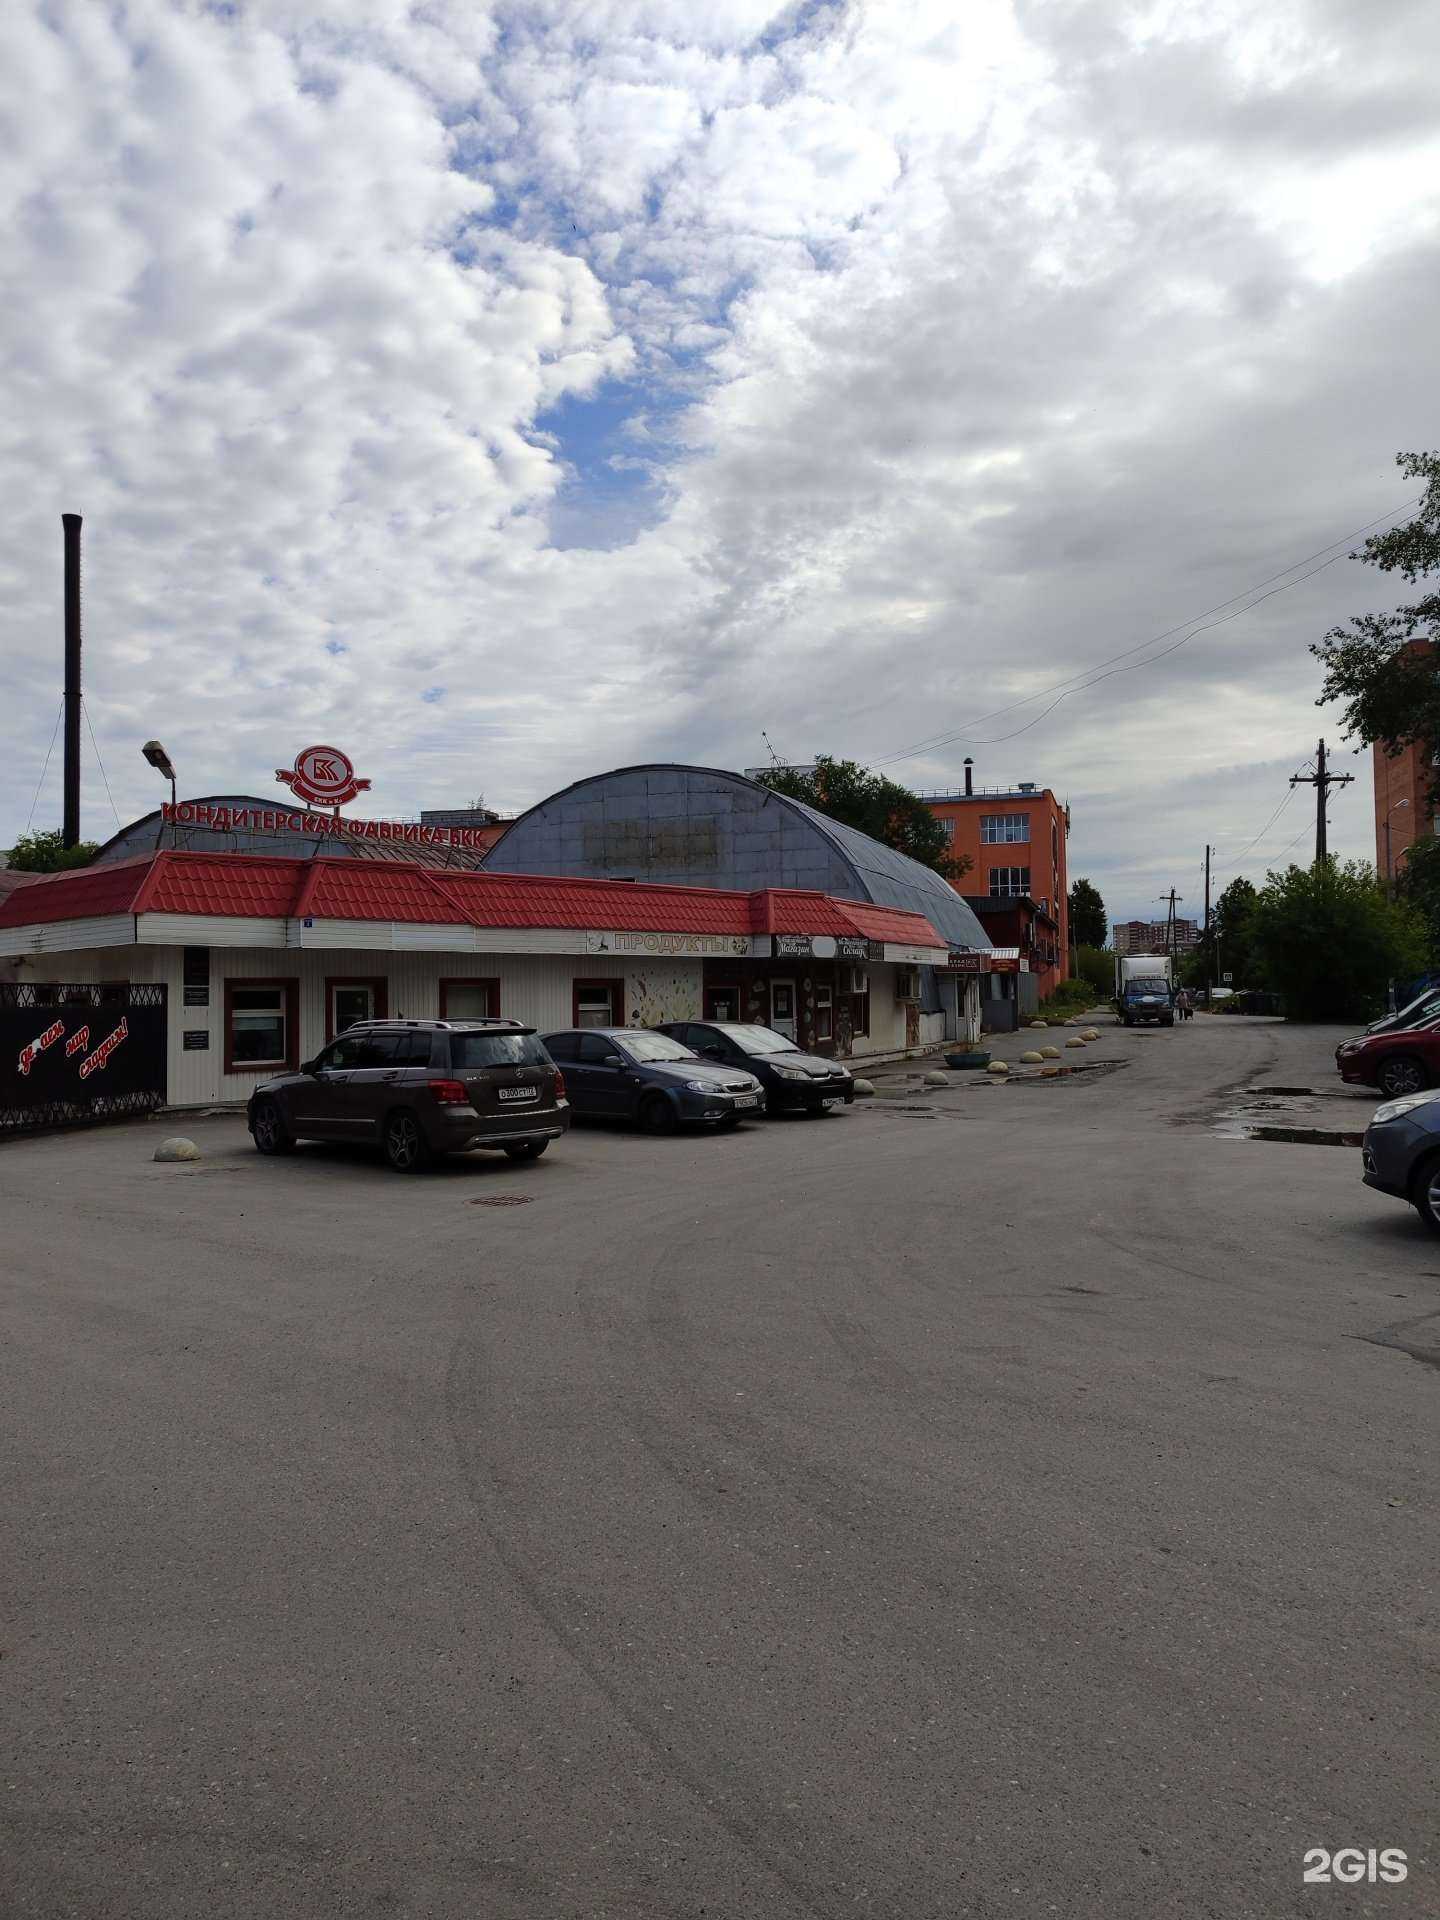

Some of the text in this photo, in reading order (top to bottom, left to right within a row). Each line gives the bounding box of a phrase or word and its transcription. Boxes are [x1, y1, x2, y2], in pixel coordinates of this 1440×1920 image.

[161, 801, 344, 835] КОНДИТЕРСКАЯ
[349, 819, 444, 844] ФАБРИКА
[614, 933, 729, 953] ПРОДУКТЫ
[16, 1020, 65, 1075] деаем
[66, 1025, 90, 1058] мир
